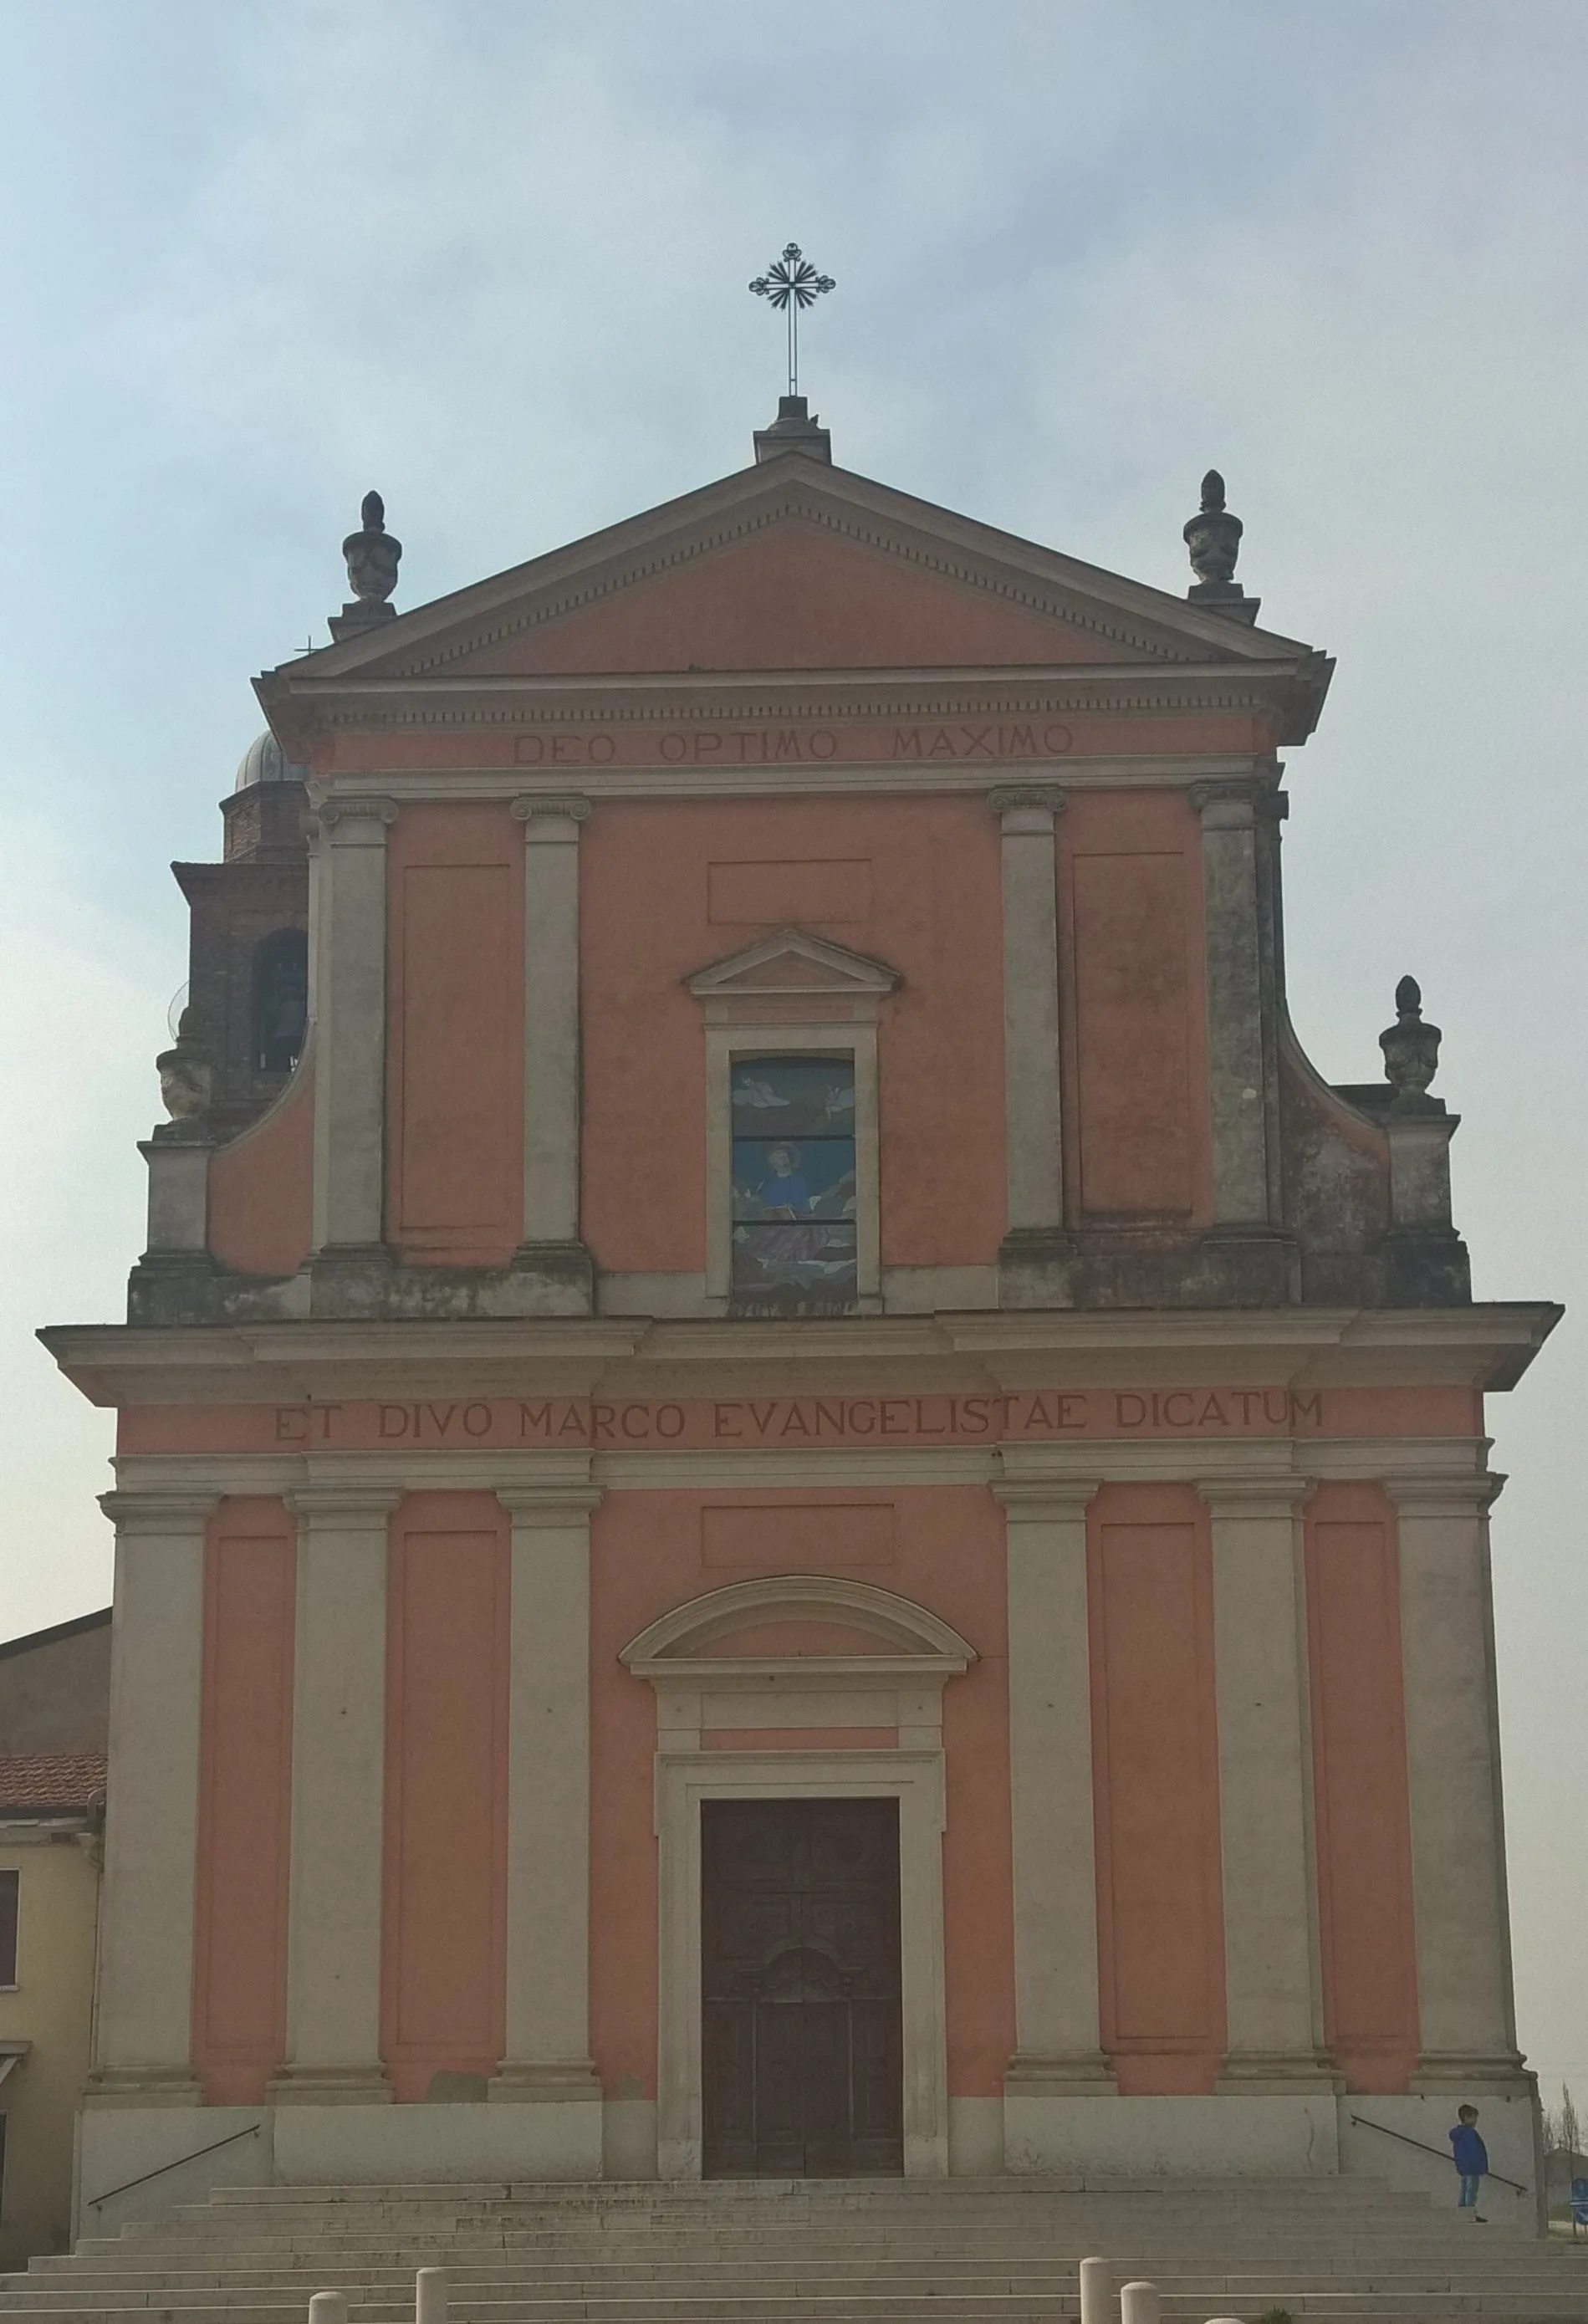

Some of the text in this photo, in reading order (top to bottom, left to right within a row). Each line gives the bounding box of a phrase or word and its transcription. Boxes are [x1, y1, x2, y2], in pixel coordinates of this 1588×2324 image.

[513, 724, 1074, 764] DEO OPTIMO MAXIMO
[274, 1391, 1324, 1441] ET DIVO MARCO EVANGELISTAE DICATUM
